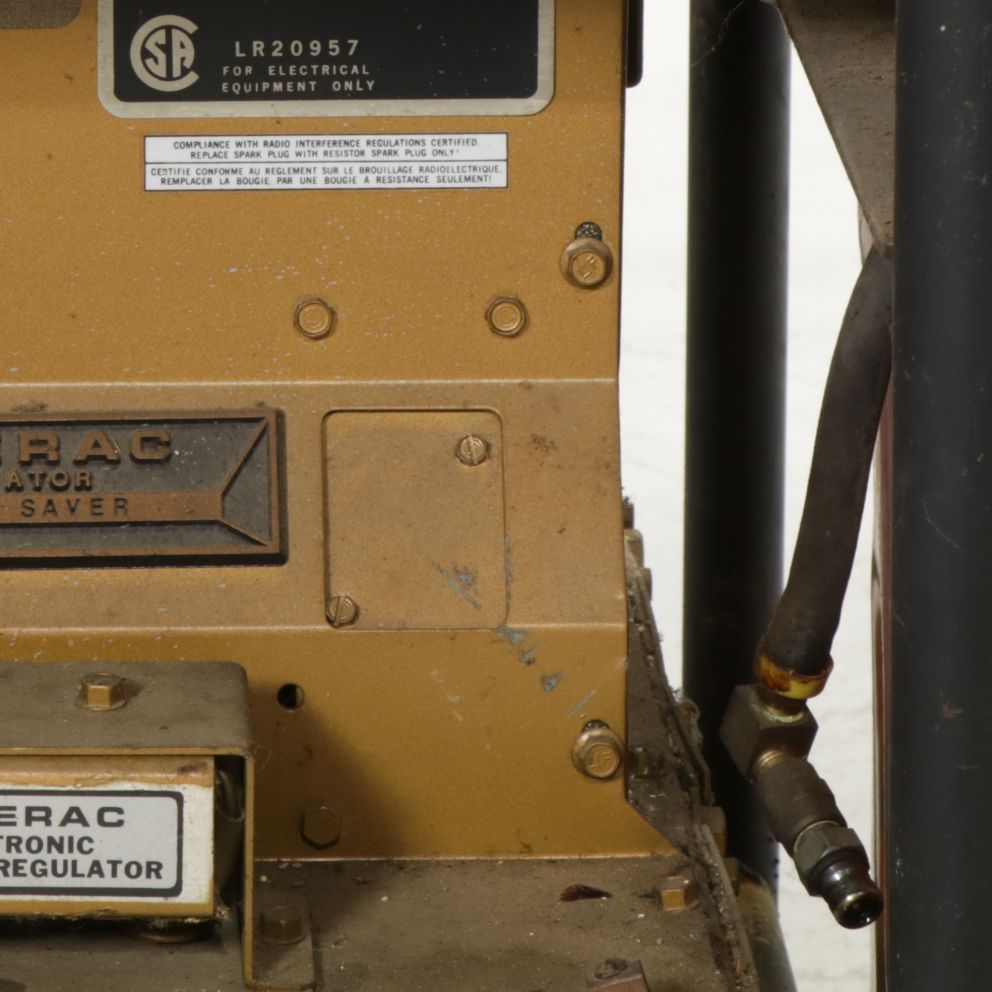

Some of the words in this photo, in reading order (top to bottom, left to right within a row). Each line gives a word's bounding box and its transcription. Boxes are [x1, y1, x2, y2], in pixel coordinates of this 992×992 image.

[235, 39, 358, 56] LR20957
[222, 66, 252, 76] FOR
[268, 64, 368, 75] ELECTRICAL
[222, 81, 316, 94] EQUIPMENT
[332, 80, 374, 93] ONLY
[173, 140, 229, 149] COMPLIANCE
[235, 140, 258, 148] WITH
[263, 139, 290, 148] RADIO
[296, 139, 360, 147] INTERFERENCE
[366, 138, 425, 147] REGULATIONS
[190, 150, 228, 159] REPLACE
[234, 150, 261, 158] SPARK
[268, 150, 289, 158] PLUG
[295, 149, 317, 158] WITH
[323, 149, 365, 157] RESISTOR
[371, 149, 398, 157] SPARK
[405, 148, 426, 156] PLUG
[195, 167, 242, 175] CONFORME
[265, 167, 316, 175] REGLEMENT
[322, 166, 338, 174] SUR
[344, 166, 352, 174] LE
[359, 166, 412, 174] BROUILLAGE
[160, 177, 212, 185] REMPLACER
[219, 177, 229, 185] LA
[236, 177, 268, 185] BOUGIE
[276, 176, 292, 184] PAR
[300, 176, 316, 184] UNE
[324, 176, 356, 184] BOUGIE
[376, 175, 429, 183] RESISTANCE
[22, 496, 130, 518] SAVER
